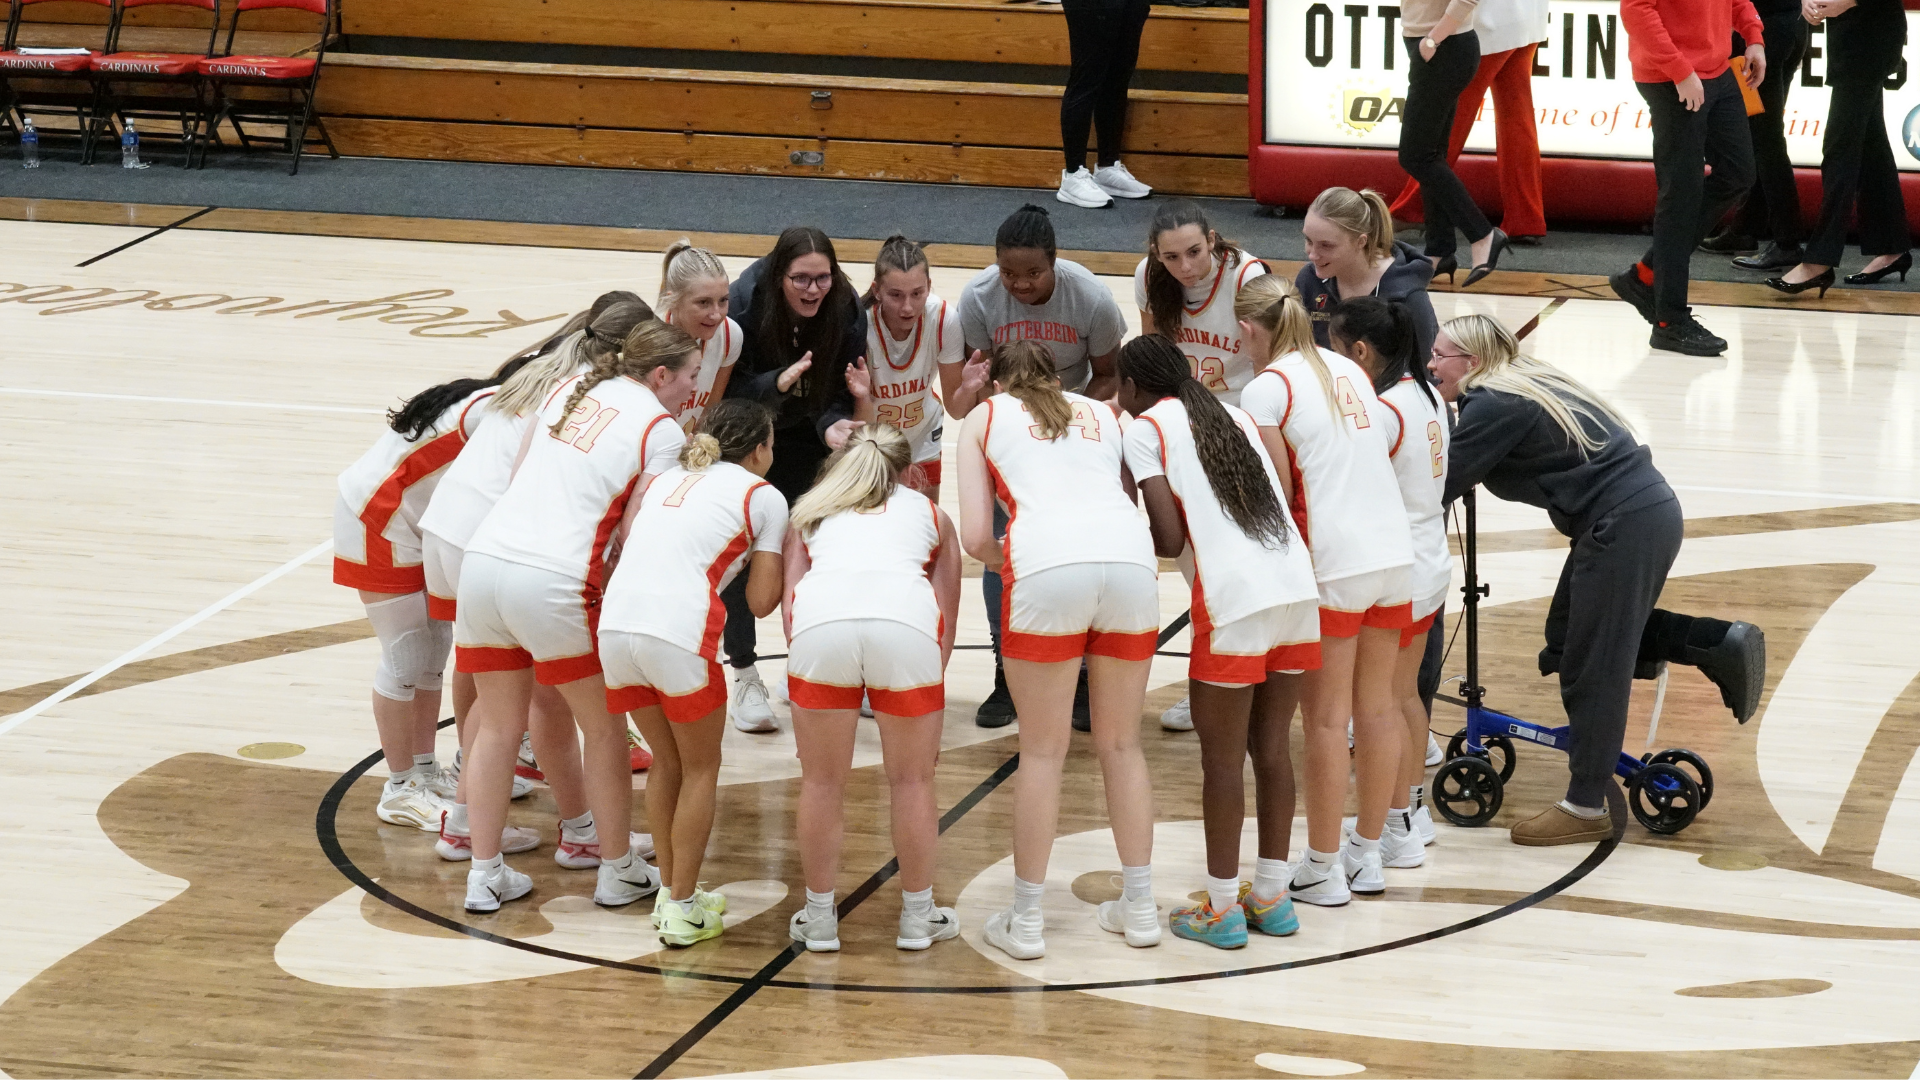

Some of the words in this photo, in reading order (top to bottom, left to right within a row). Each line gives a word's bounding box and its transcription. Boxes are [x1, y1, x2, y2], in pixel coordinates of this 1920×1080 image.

[100, 62, 160, 74] CARDINALS
[209, 64, 267, 77] CARDINALS
[1590, 102, 1629, 136] of
[994, 320, 1078, 345] OTTERBEIN
[1175, 327, 1241, 354] RDINALS
[549, 396, 620, 453] 21
[877, 397, 925, 429] 25
[1427, 420, 1443, 479] 2
[662, 473, 706, 508] 1
